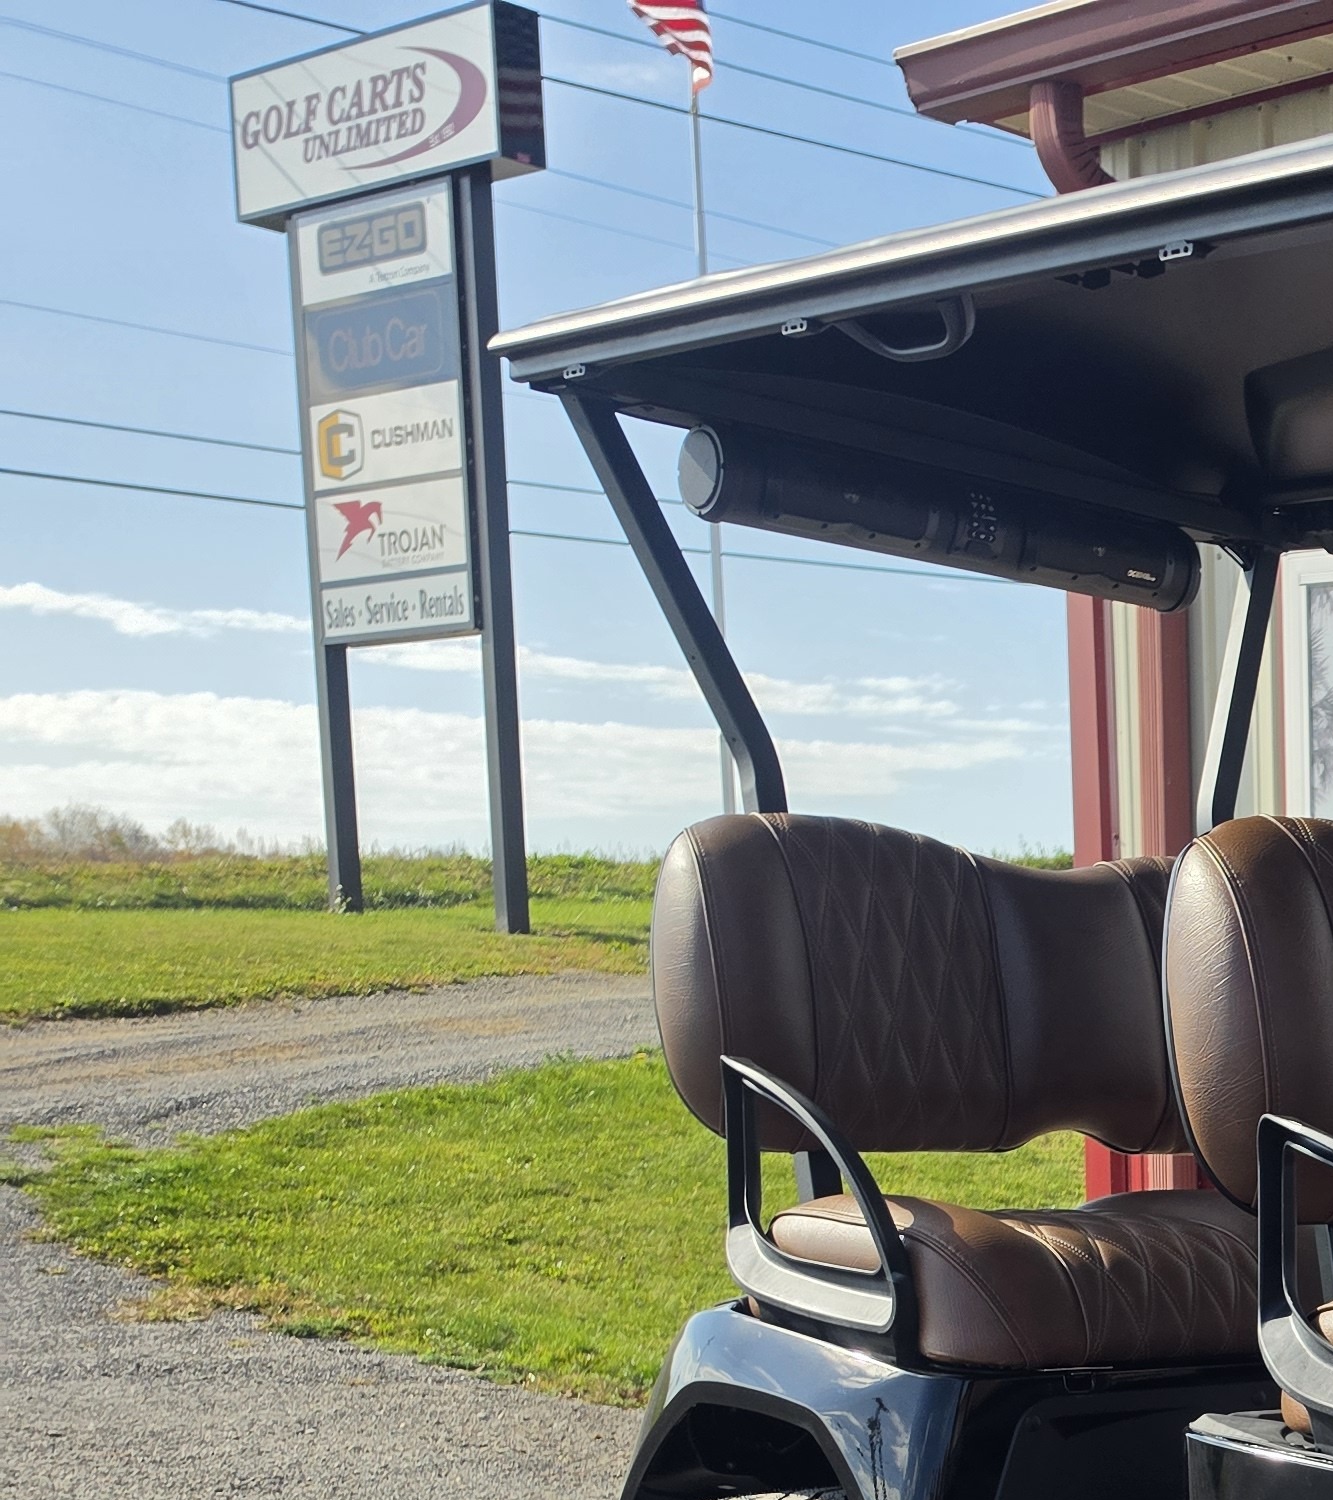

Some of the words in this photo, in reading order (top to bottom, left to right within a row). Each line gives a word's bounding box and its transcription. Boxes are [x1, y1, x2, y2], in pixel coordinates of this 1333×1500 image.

[241, 92, 320, 150] GOLF
[326, 61, 427, 126] CARTS
[302, 106, 426, 164] UNLIMITED
[321, 208, 425, 267] EZGO
[328, 323, 382, 372] Club
[386, 317, 427, 361] Car
[371, 418, 454, 449] CUSHMAN
[377, 526, 444, 557] TROJAN
[326, 600, 356, 629] Sales
[366, 592, 409, 624] Service
[419, 585, 465, 619] Rentals
